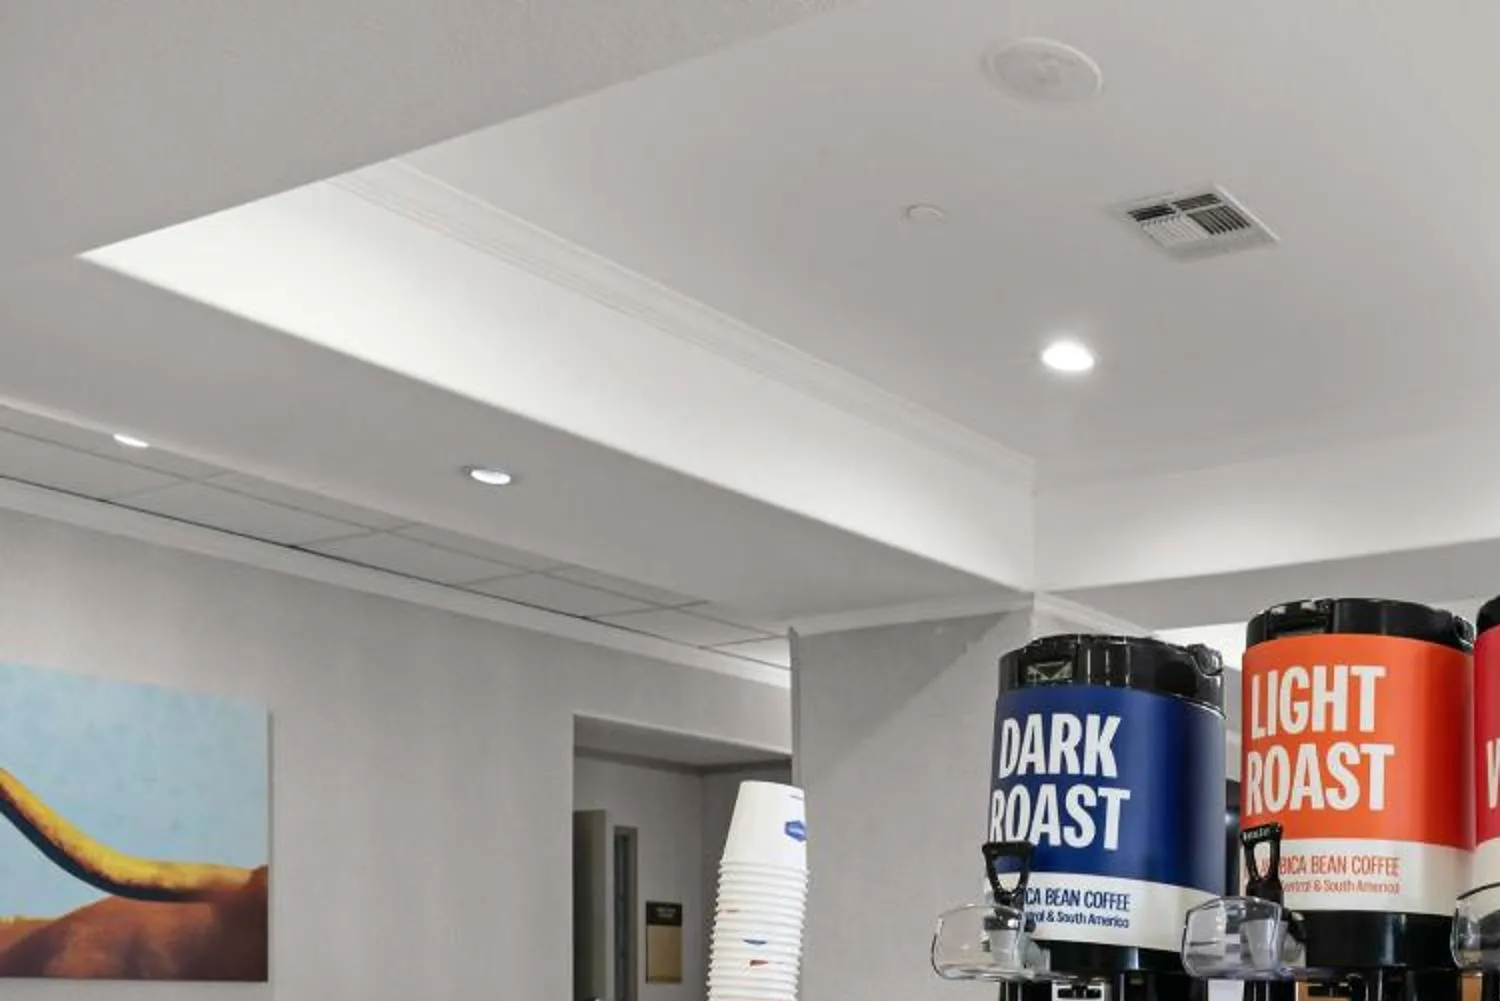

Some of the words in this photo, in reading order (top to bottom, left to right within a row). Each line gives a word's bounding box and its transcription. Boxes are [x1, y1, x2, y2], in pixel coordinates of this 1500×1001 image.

[1251, 665, 1386, 739] LIGHT
[998, 713, 1121, 779] DARK
[1246, 742, 1395, 816] ROAST
[989, 784, 1130, 850] ROAST
[1311, 855, 1347, 876] BEAN
[1351, 856, 1400, 877] COFFEE
[1324, 880, 1355, 893] South
[1357, 881, 1400, 895] America
[1045, 887, 1081, 907] BEAN
[1084, 891, 1130, 912] COFFEE
[1057, 911, 1087, 925] South
[1088, 913, 1129, 929] America
